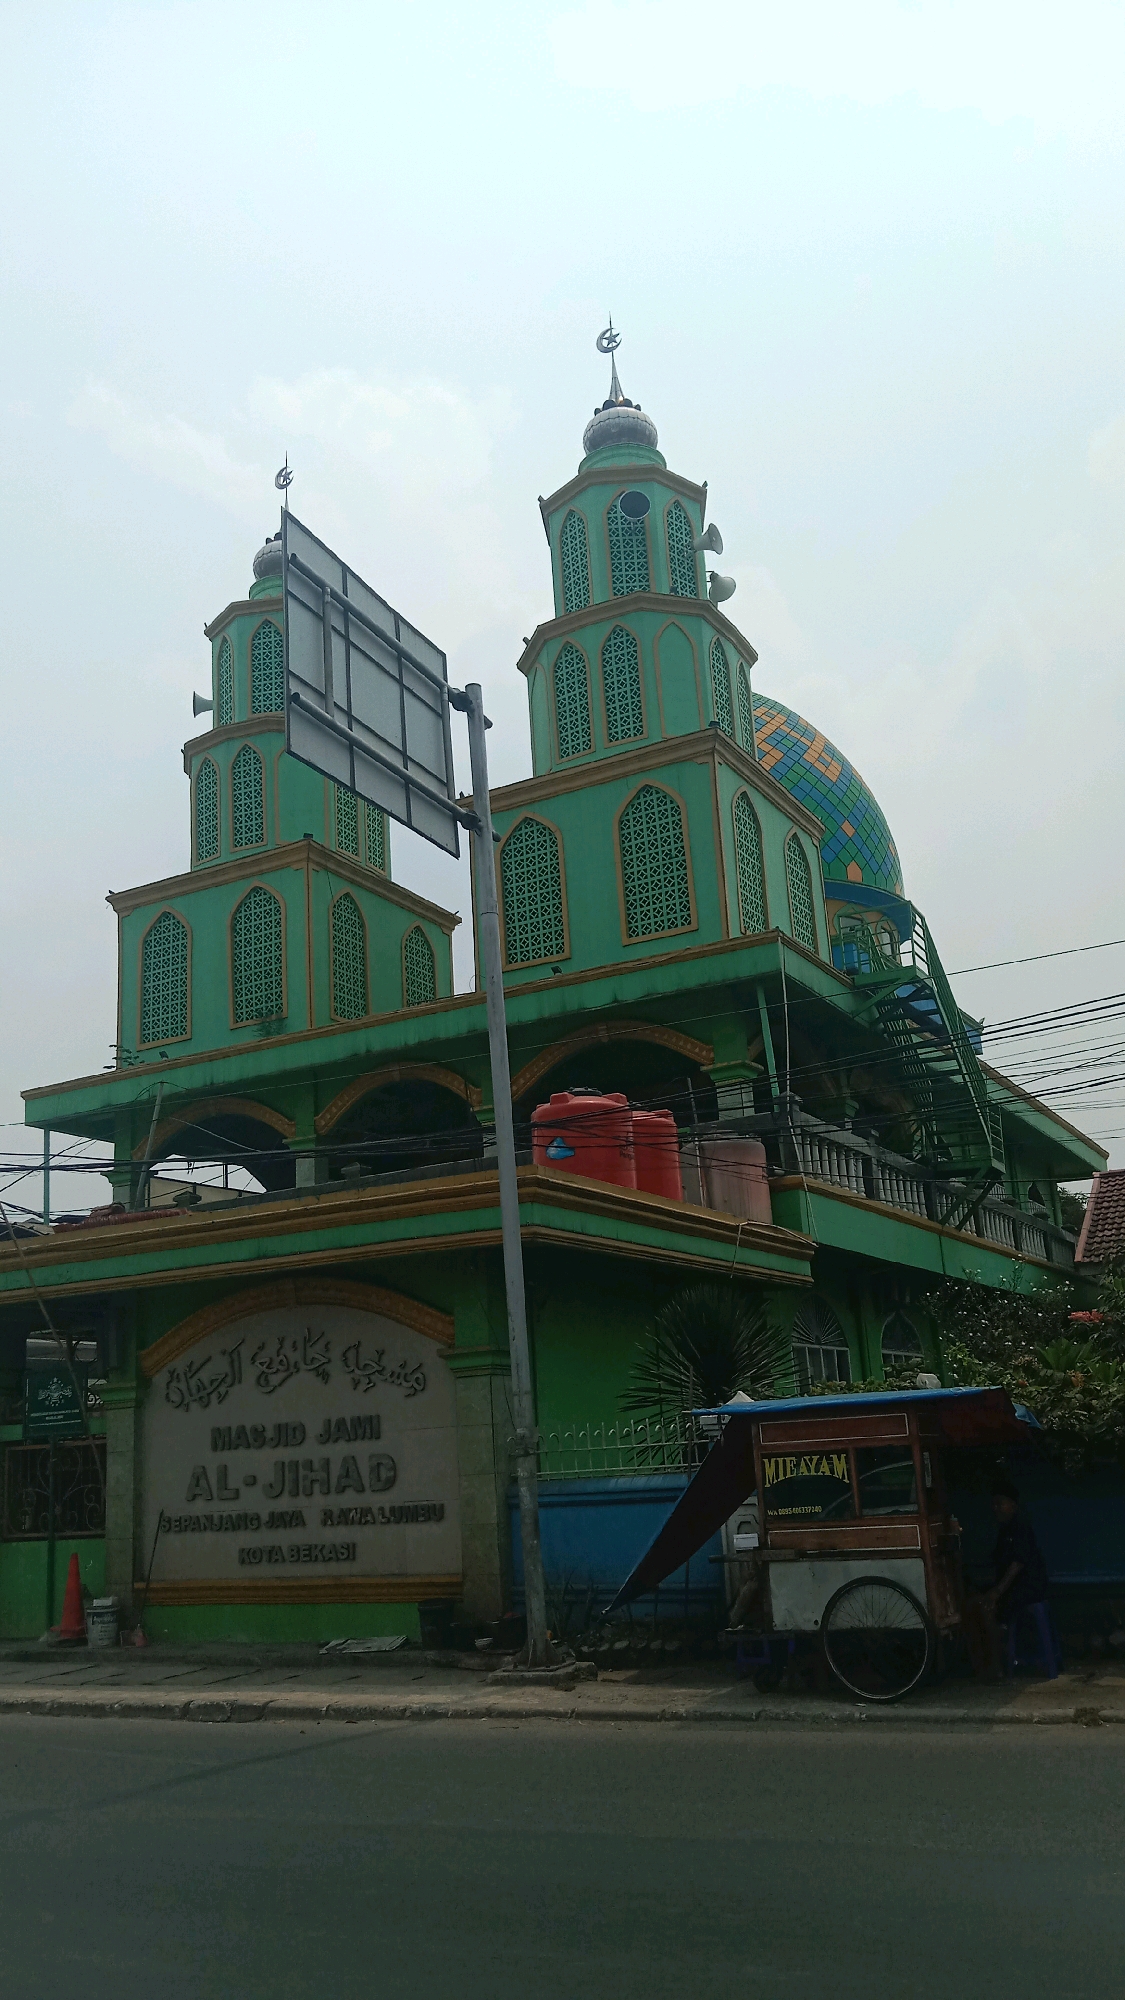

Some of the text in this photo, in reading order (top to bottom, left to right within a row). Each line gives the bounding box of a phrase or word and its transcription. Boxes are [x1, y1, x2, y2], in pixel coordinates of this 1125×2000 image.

[211, 1414, 381, 1451] MASJID JAMI
[763, 1453, 850, 1488] MIE AYAM
[160, 1502, 444, 1533] SEPANJANG JAYA RAWA LUMBU
[238, 1541, 357, 1565] KOTA BEKASI
